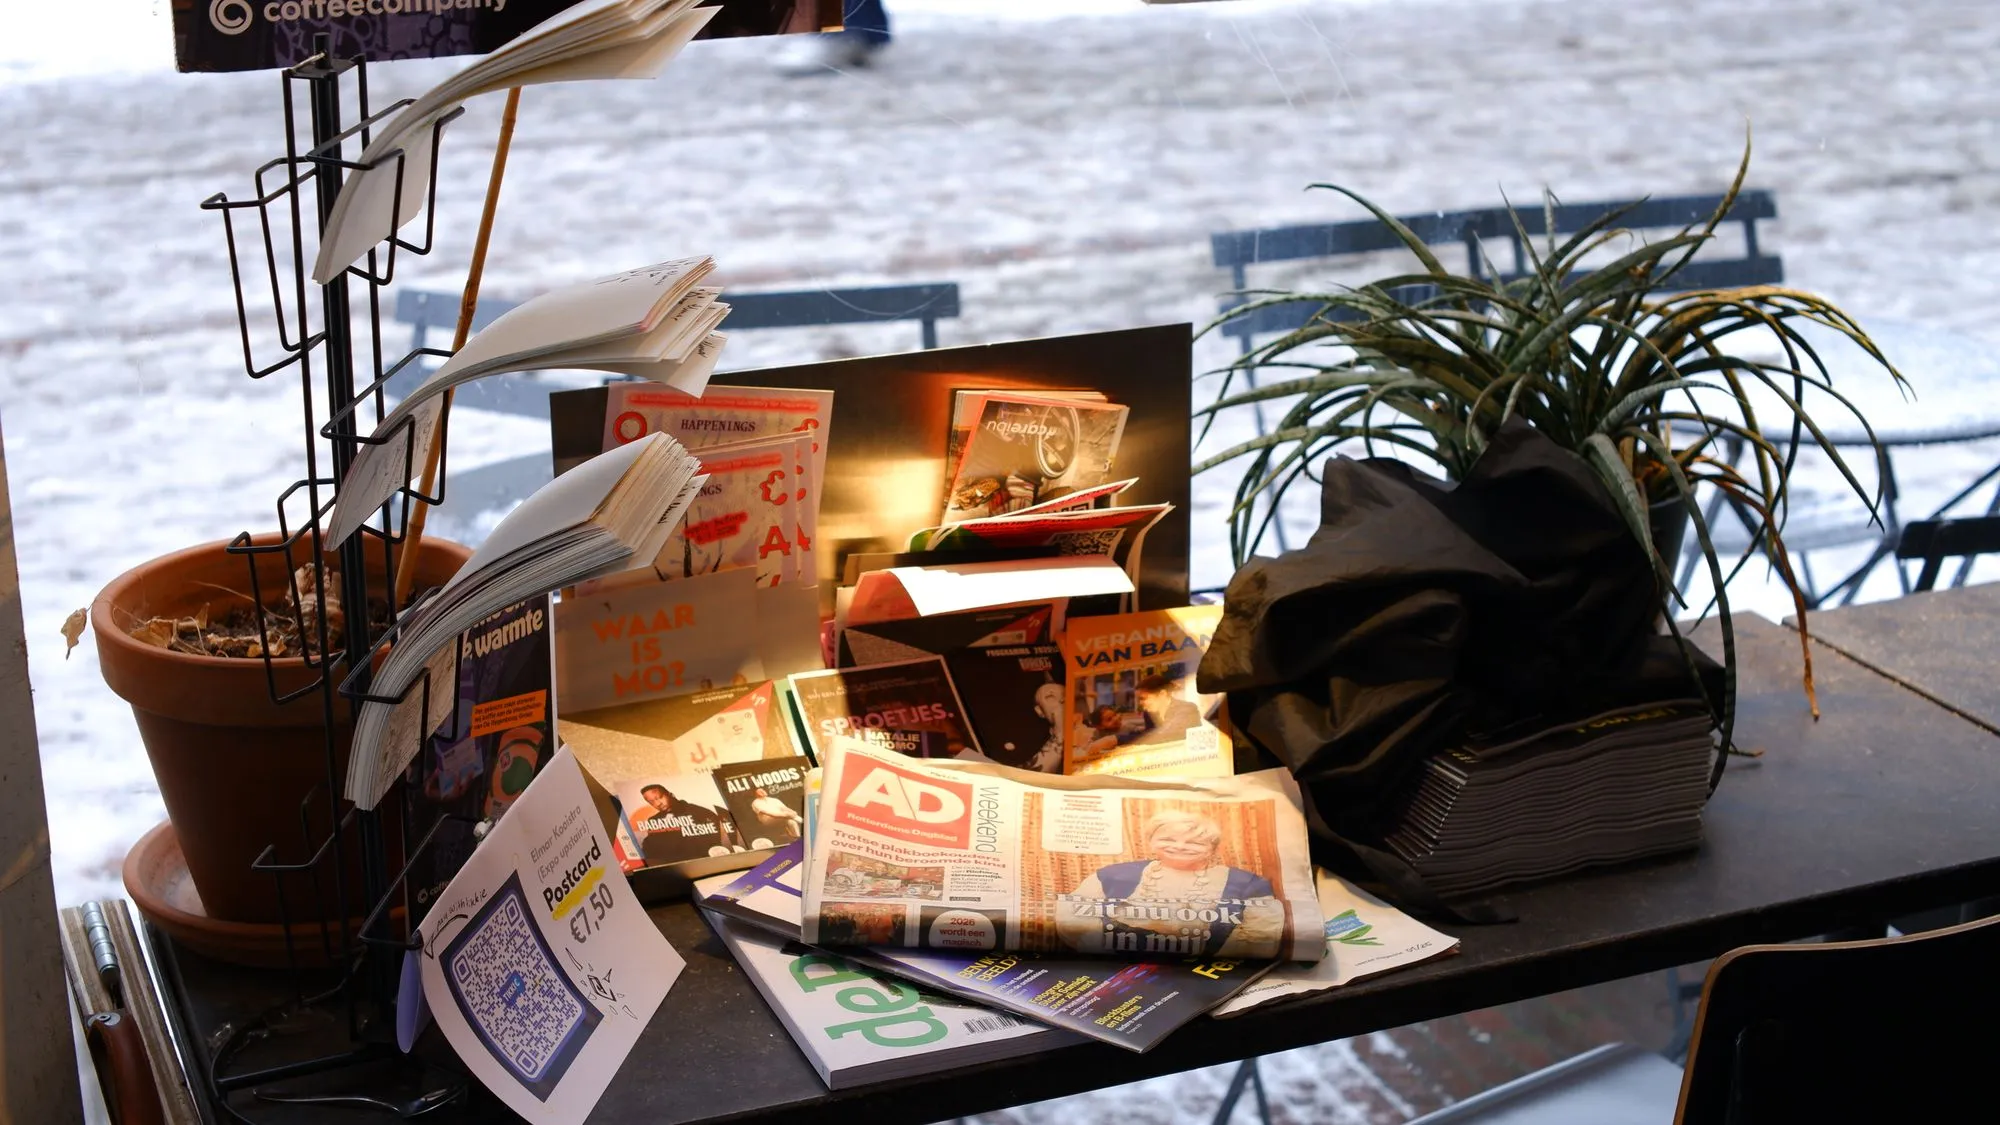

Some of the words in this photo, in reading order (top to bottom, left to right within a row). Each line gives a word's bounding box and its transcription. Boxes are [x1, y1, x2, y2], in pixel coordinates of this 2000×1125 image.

[680, 419, 756, 433] HAPPENINGS
[475, 608, 543, 658] warmte
[592, 604, 696, 643] WAAR
[631, 636, 662, 665] IS
[1074, 647, 1131, 668] VAN
[613, 660, 686, 698] MO?
[820, 703, 954, 737] SPROETJES.
[868, 731, 920, 742] NATALIE
[727, 778, 750, 794] ALI
[750, 767, 799, 789] WOODS
[844, 767, 965, 824] AD
[637, 814, 694, 832] BABATUNDE
[846, 812, 911, 835] Rotterdams
[911, 828, 959, 842] Dagblad
[975, 786, 1005, 856] weekend
[530, 836, 553, 863] Elmar
[537, 856, 560, 883] (Expo
[560, 819, 590, 859] upstairs)
[833, 828, 879, 848] Trotse
[830, 839, 864, 852] over
[866, 844, 893, 860] hun
[895, 852, 972, 864] beroemde
[974, 858, 1007, 869] kind
[543, 835, 602, 912] Postcard
[569, 882, 614, 944] €7,50
[949, 916, 976, 927] 2026
[1072, 902, 1117, 919] zit
[1123, 903, 1171, 922] nu
[1176, 904, 1242, 926] ook
[939, 927, 970, 938] wordt
[970, 928, 985, 938] een
[1103, 923, 1138, 952] in
[956, 959, 987, 980] BEN
